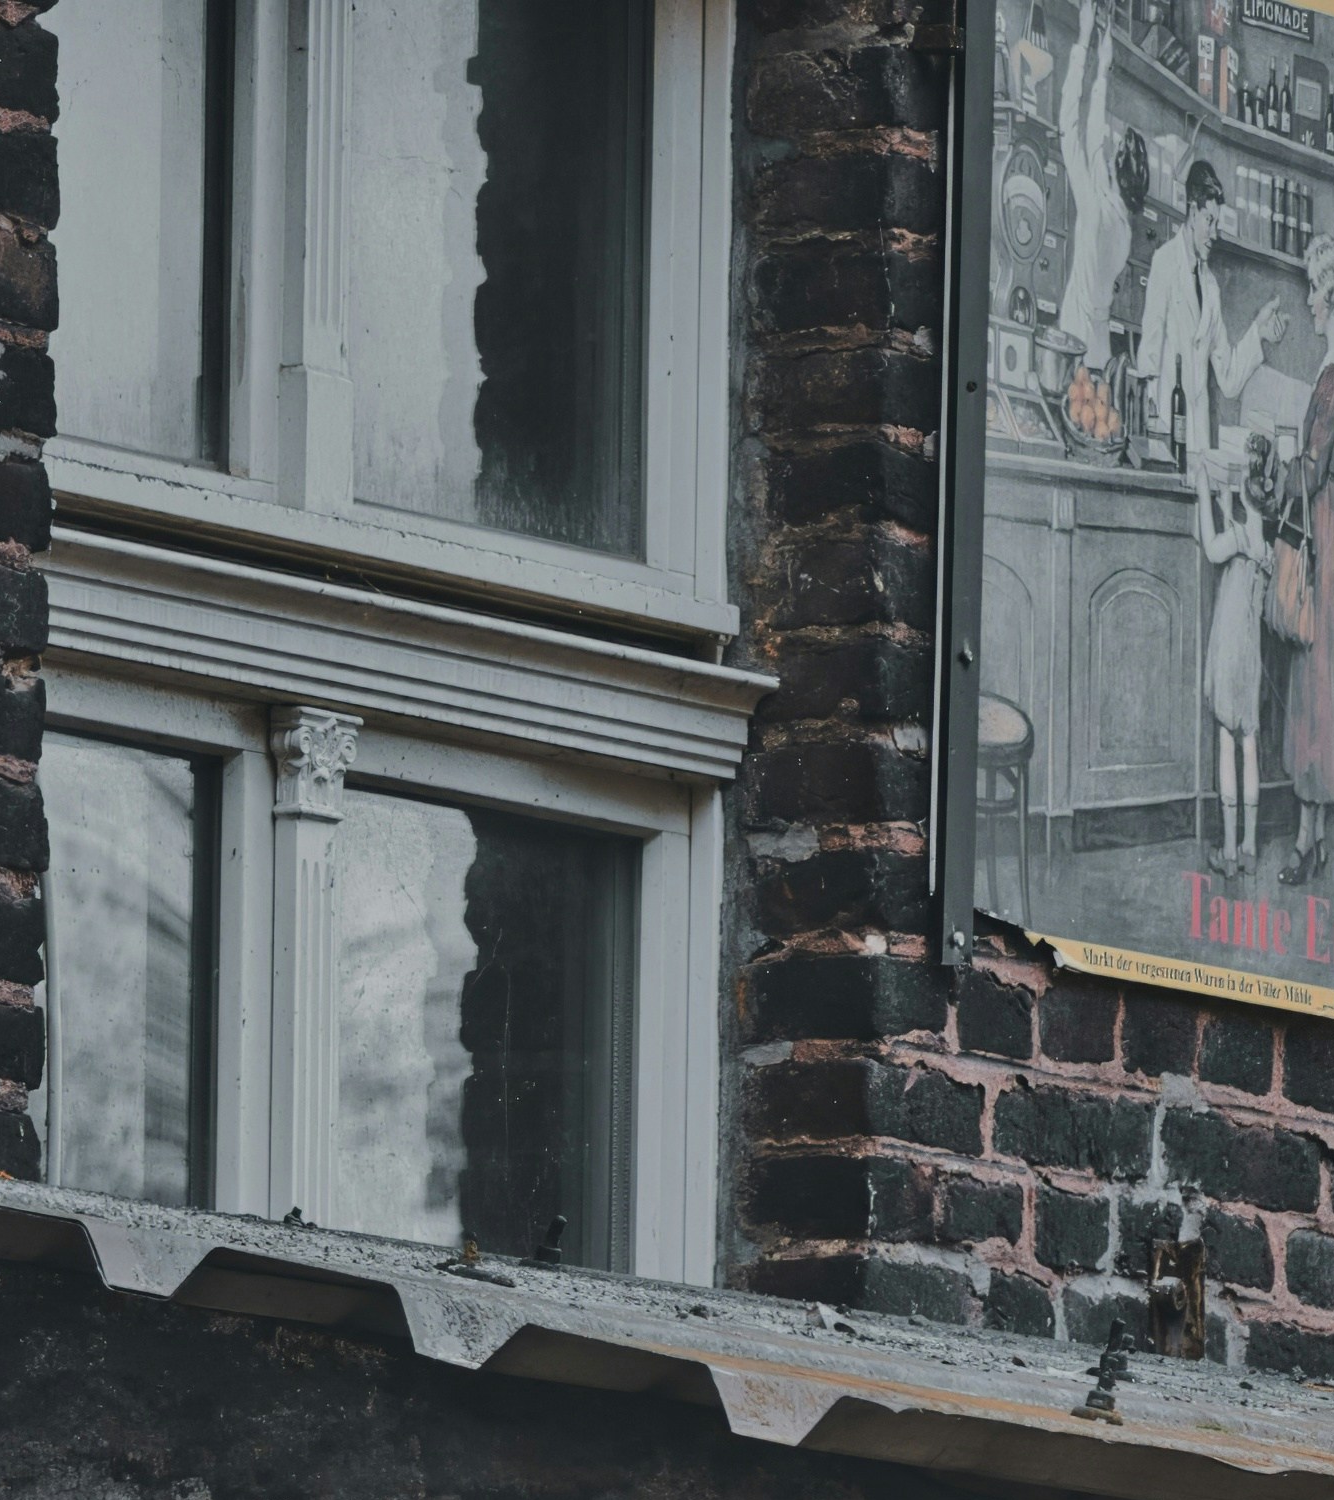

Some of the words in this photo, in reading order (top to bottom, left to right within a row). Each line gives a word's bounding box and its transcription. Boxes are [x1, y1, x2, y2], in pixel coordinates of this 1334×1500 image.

[1243, 0, 1309, 33] LIMONADE
[1182, 869, 1292, 955] Tante
[1083, 947, 1113, 968] Markt
[1116, 954, 1133, 971] der
[1227, 973, 1236, 990] in
[1238, 976, 1254, 994] der
